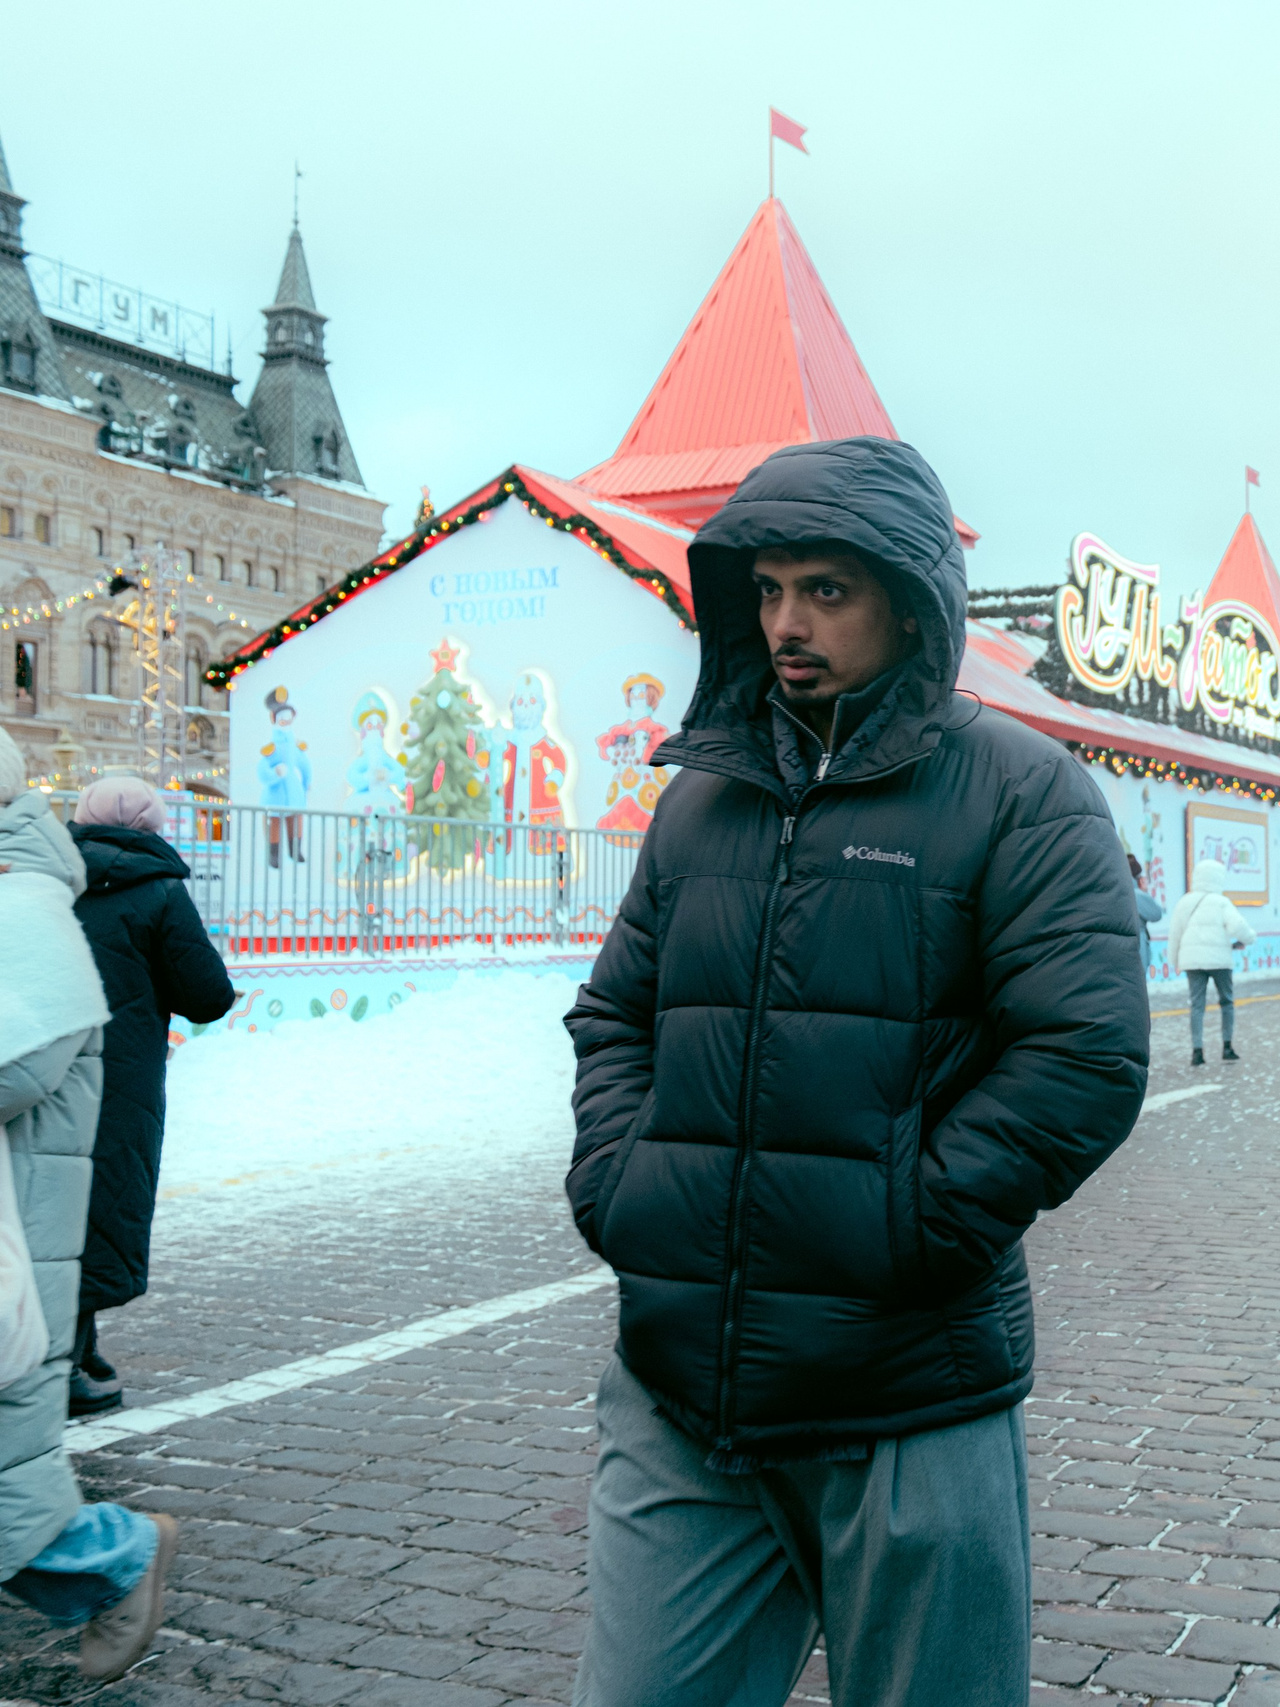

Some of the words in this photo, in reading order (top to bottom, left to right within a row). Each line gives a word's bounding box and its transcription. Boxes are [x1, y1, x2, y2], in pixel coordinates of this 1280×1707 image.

[73, 278, 168, 336] ГУМ
[430, 575, 445, 597] С
[455, 567, 559, 595] НОВЫМ
[443, 597, 545, 625] ГОДОМ!
[855, 846, 916, 867] Columbia
